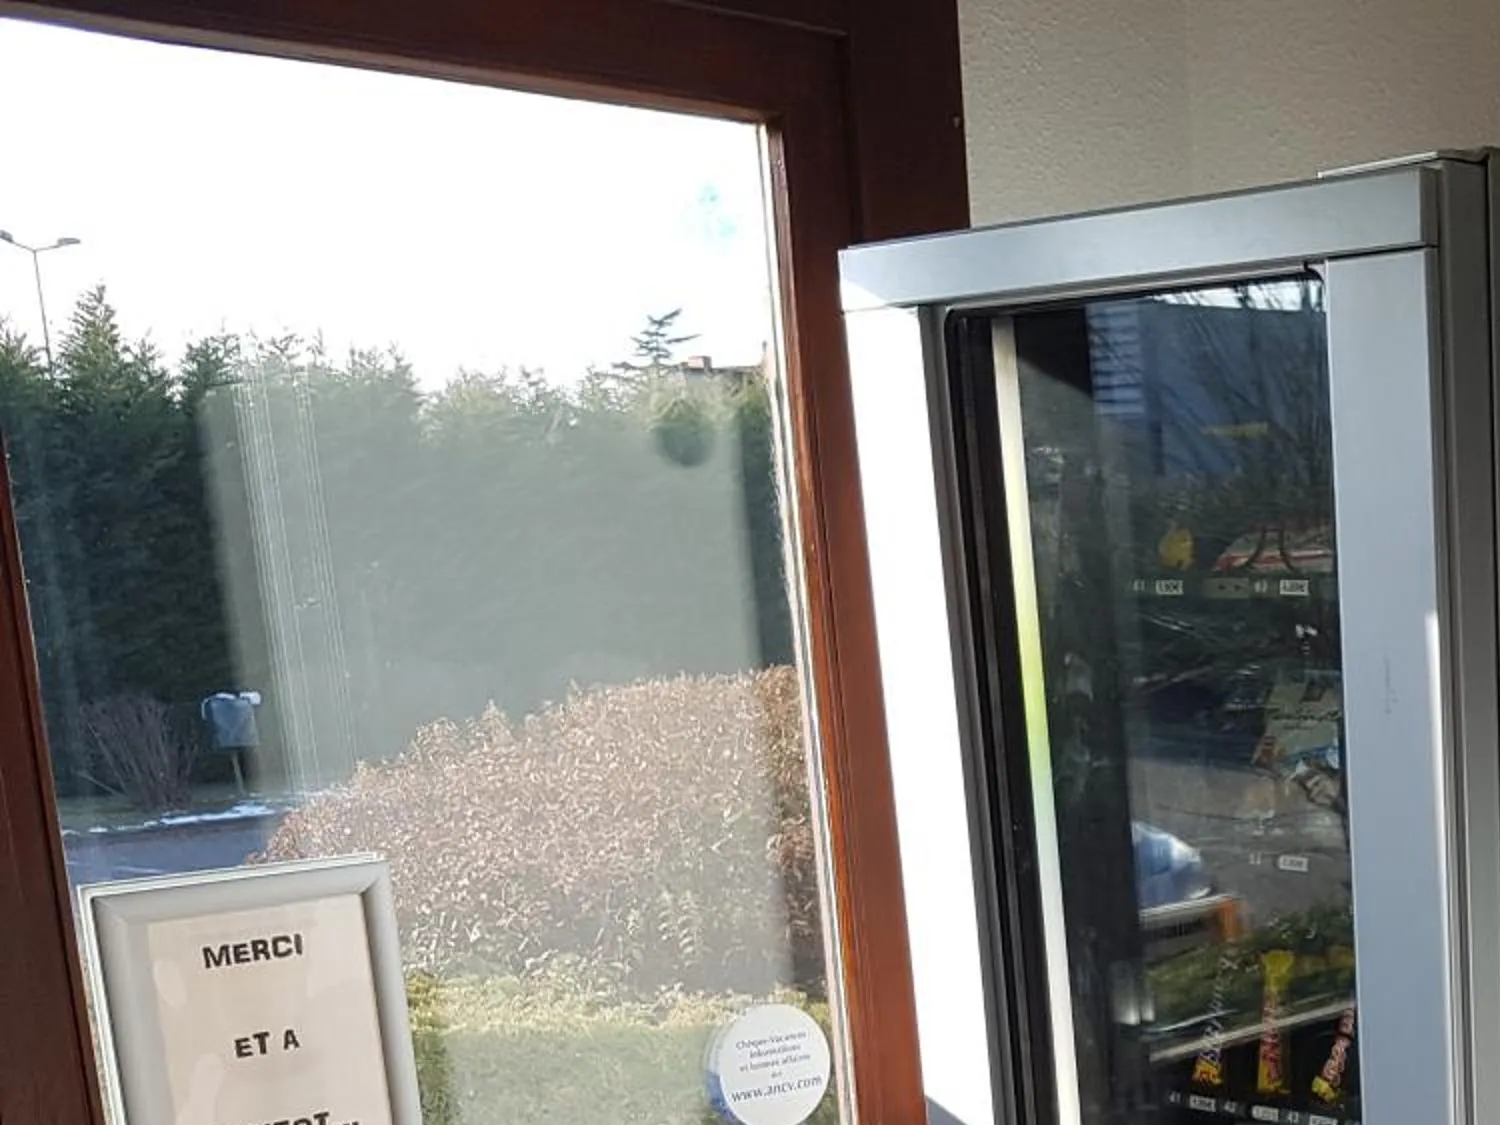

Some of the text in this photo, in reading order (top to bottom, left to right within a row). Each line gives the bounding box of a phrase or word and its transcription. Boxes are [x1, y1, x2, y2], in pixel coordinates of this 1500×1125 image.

[202, 933, 304, 970] MERCI
[234, 1029, 301, 1059] ET A
